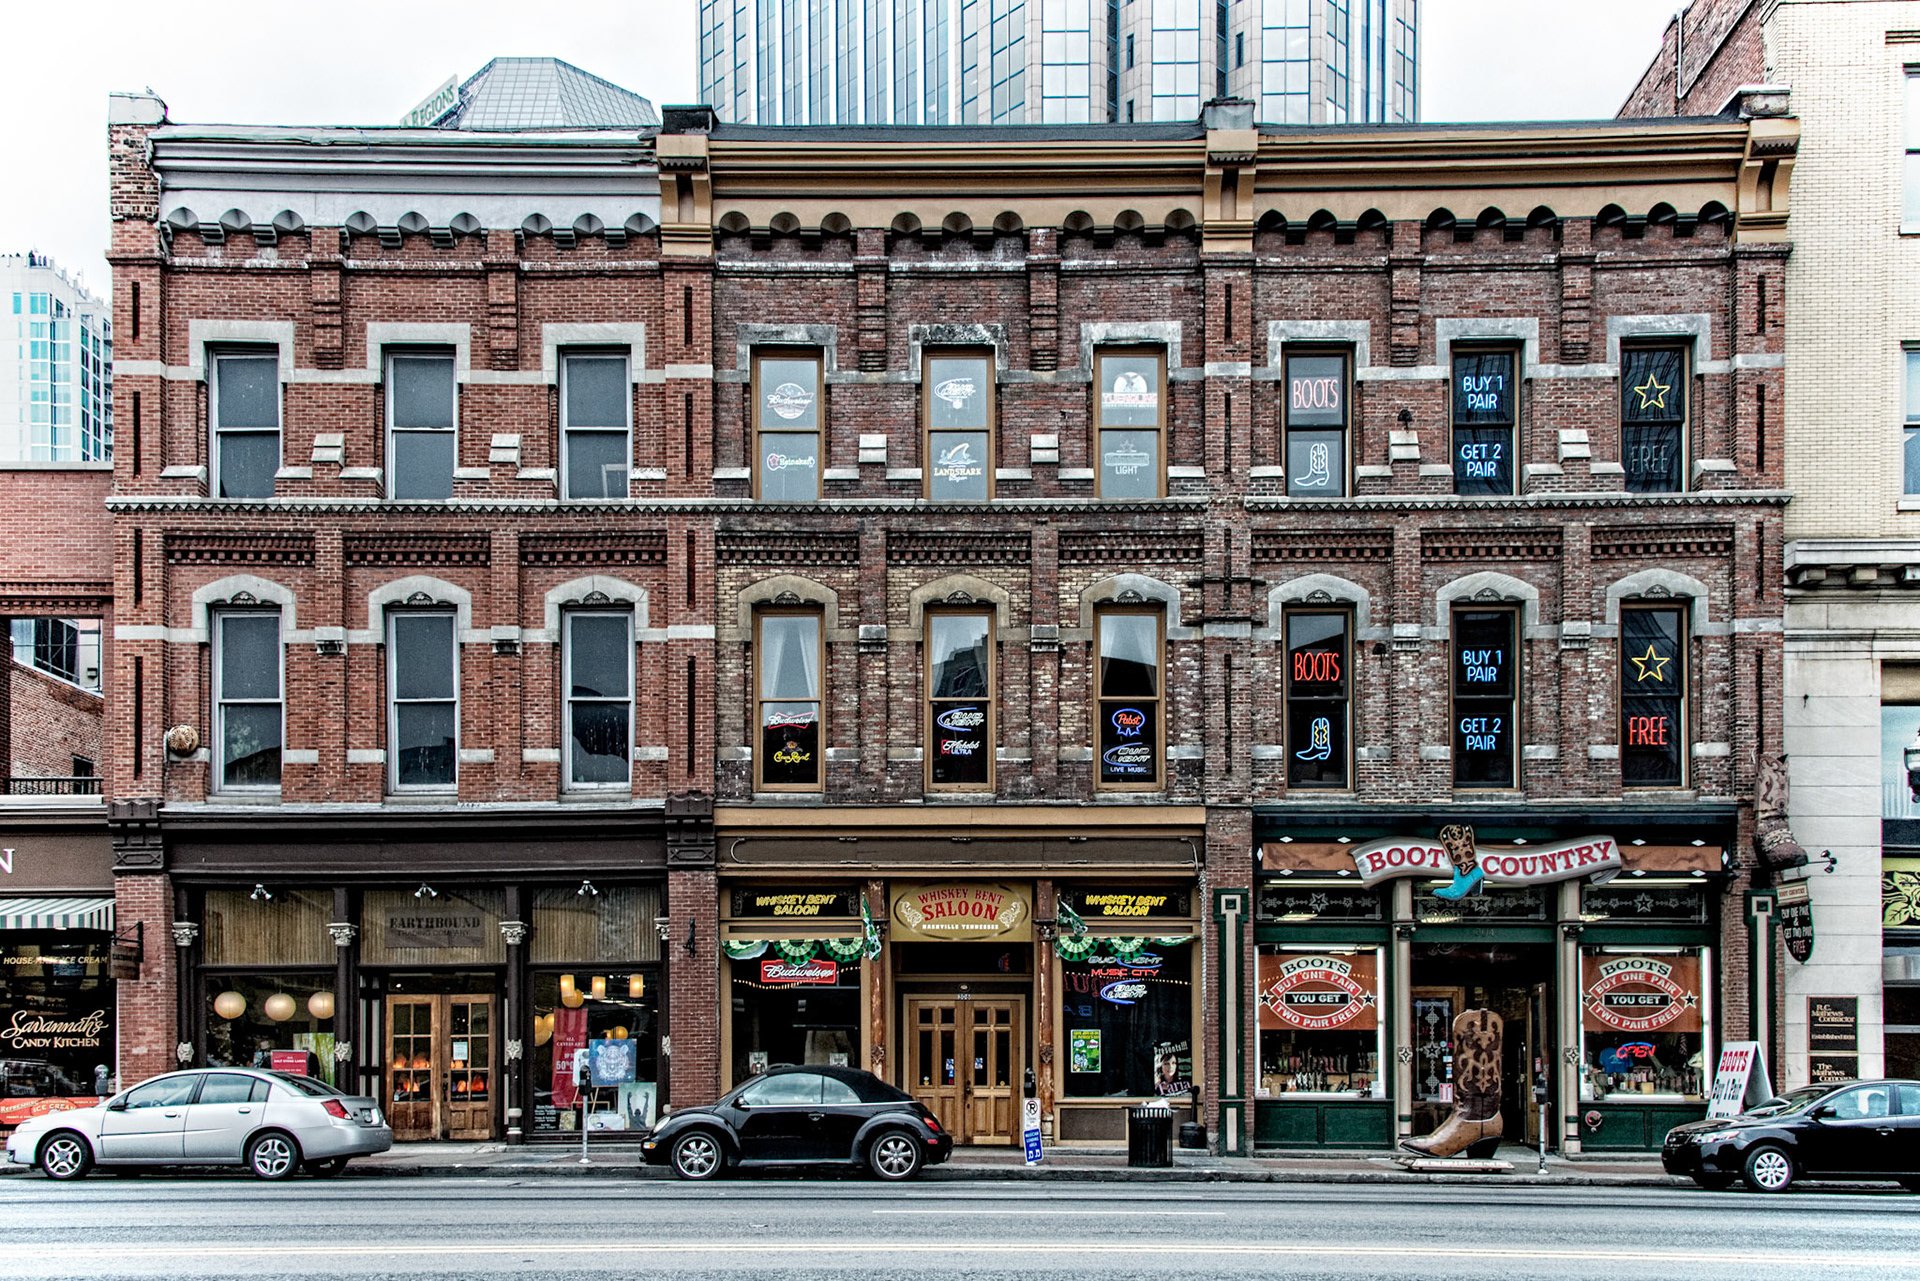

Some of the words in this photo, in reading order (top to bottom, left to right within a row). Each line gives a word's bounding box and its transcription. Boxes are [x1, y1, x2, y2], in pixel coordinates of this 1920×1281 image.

[411, 84, 454, 127] REGIONS
[1463, 376, 1492, 392] BUY
[1497, 375, 1503, 391] 1
[767, 394, 812, 405] Budweiser
[1293, 379, 1339, 409] BOOTS
[1467, 393, 1498, 409] PAIR
[1460, 444, 1488, 460] GET
[1493, 443, 1501, 459] 2
[1631, 445, 1668, 474] FREE
[934, 467, 982, 477] LANDSHARK
[1115, 466, 1139, 475] LIGHT
[1466, 461, 1496, 477] PAIR
[1462, 650, 1491, 665] BUY
[1495, 650, 1502, 665] 1
[1295, 652, 1340, 681] BOOTS
[1467, 666, 1497, 682] PAIR
[768, 716, 813, 725] Budweiser
[944, 718, 984, 726] LIGHT
[1118, 713, 1141, 726] Pabst
[1460, 717, 1488, 733] GET
[1493, 717, 1501, 733] 2
[1629, 716, 1668, 746] FREE
[943, 740, 980, 750] Michelob
[1466, 734, 1496, 750] PAIR
[1118, 747, 1150, 755] BUD
[1110, 755, 1151, 763] LIGHT
[1367, 846, 1445, 873] BOOT
[1482, 841, 1613, 876] COUNTRY
[756, 894, 806, 907] WHISKEY
[805, 894, 837, 905] BENT
[918, 888, 969, 904] WHISKEY
[975, 889, 1004, 905] BENT
[1085, 895, 1137, 906] WHISKEY
[1135, 895, 1167, 906] BENT
[774, 905, 820, 916] SALOON
[921, 900, 999, 921] SALOON
[1103, 905, 1150, 916] SALOON
[1781, 908, 1790, 919] BUY
[1790, 907, 1798, 918] ONE
[1799, 905, 1809, 916] PAIR
[390, 917, 480, 929] EARTHBOUND
[1793, 917, 1799, 926] &
[1784, 928, 1792, 939] GET
[1802, 926, 1813, 937] PAIR
[1792, 940, 1806, 954] FREE
[78, 956, 108, 964] CREAM
[1088, 955, 1117, 964] BUD
[1283, 958, 1349, 975] BOOTS
[763, 965, 834, 978] Budweiser
[1091, 968, 1128, 976] MUSIC
[1602, 959, 1669, 976] BOOTS
[1113, 984, 1146, 992] BUD
[1276, 976, 1298, 993] BUY
[1302, 971, 1326, 980] ONE
[1331, 972, 1356, 993] PAIR
[1595, 976, 1617, 994] BUY
[1621, 972, 1646, 981] ONE
[1650, 975, 1677, 995] PAIR
[1107, 990, 1148, 998] LIGHT
[1292, 994, 1316, 1003] YOU
[1318, 994, 1341, 1003] GET
[1611, 995, 1635, 1005] YOU
[1638, 995, 1661, 1005] GET
[1276, 1005, 1300, 1023] TWO
[1302, 1017, 1330, 1028] PAIR
[1332, 1003, 1359, 1025] FREE
[1595, 1005, 1619, 1025] TWO
[1622, 1019, 1649, 1029] PAIR
[1651, 1004, 1680, 1027] FREE
[0, 1010, 109, 1039] Savannah's
[12, 1037, 52, 1049] CANDY
[53, 1036, 100, 1048] KITCHEN
[1616, 1044, 1656, 1059] OPEN
[1719, 1051, 1749, 1072] BOOTS
[1712, 1078, 1725, 1104] Buy
[1724, 1079, 1731, 1100] 1
[1728, 1078, 1742, 1100] Pair
[33, 1105, 47, 1113] ICE
